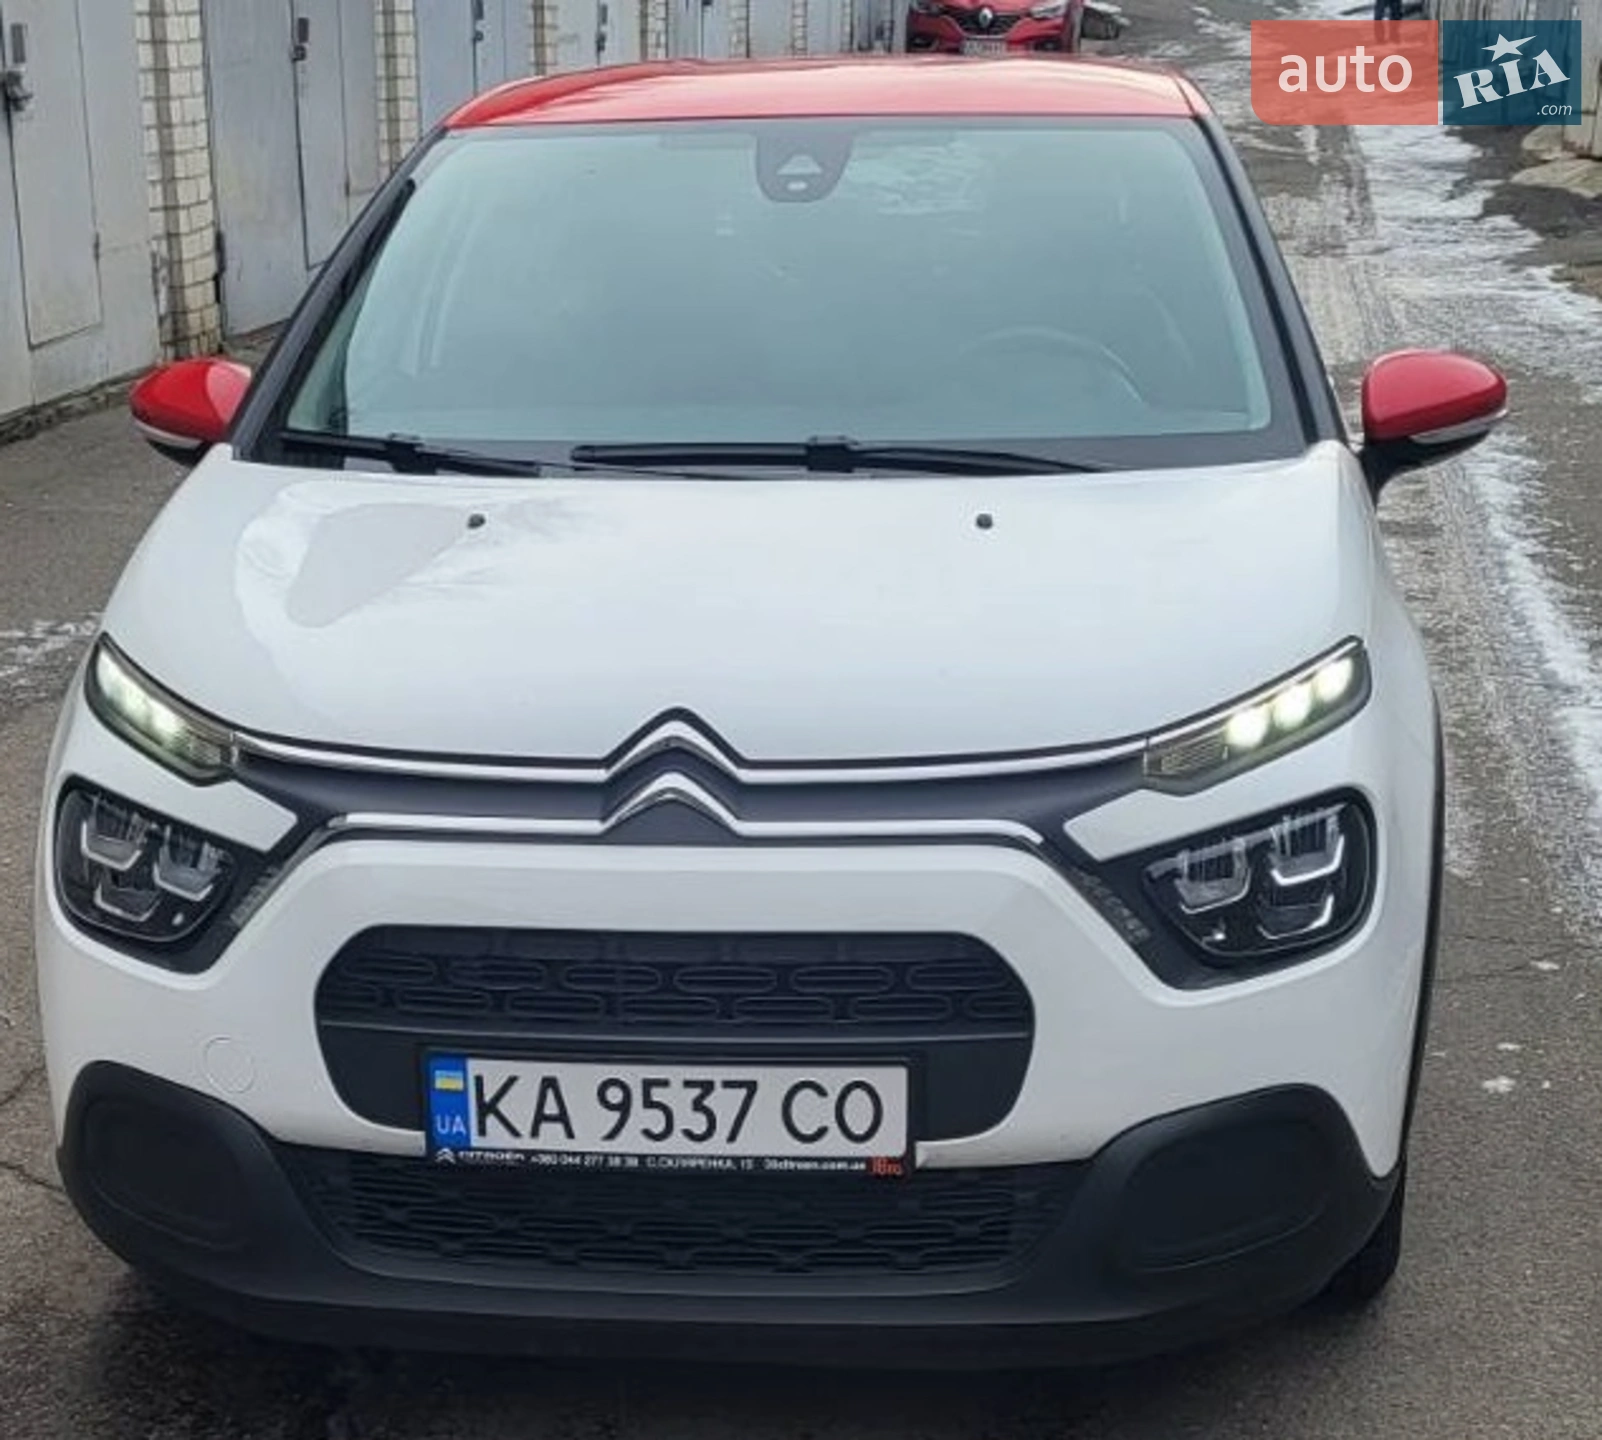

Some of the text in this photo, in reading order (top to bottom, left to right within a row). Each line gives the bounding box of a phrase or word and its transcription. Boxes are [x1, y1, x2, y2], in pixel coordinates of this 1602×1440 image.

[436, 1115, 467, 1135] UA
[473, 1074, 884, 1144] KA 9537 CO
